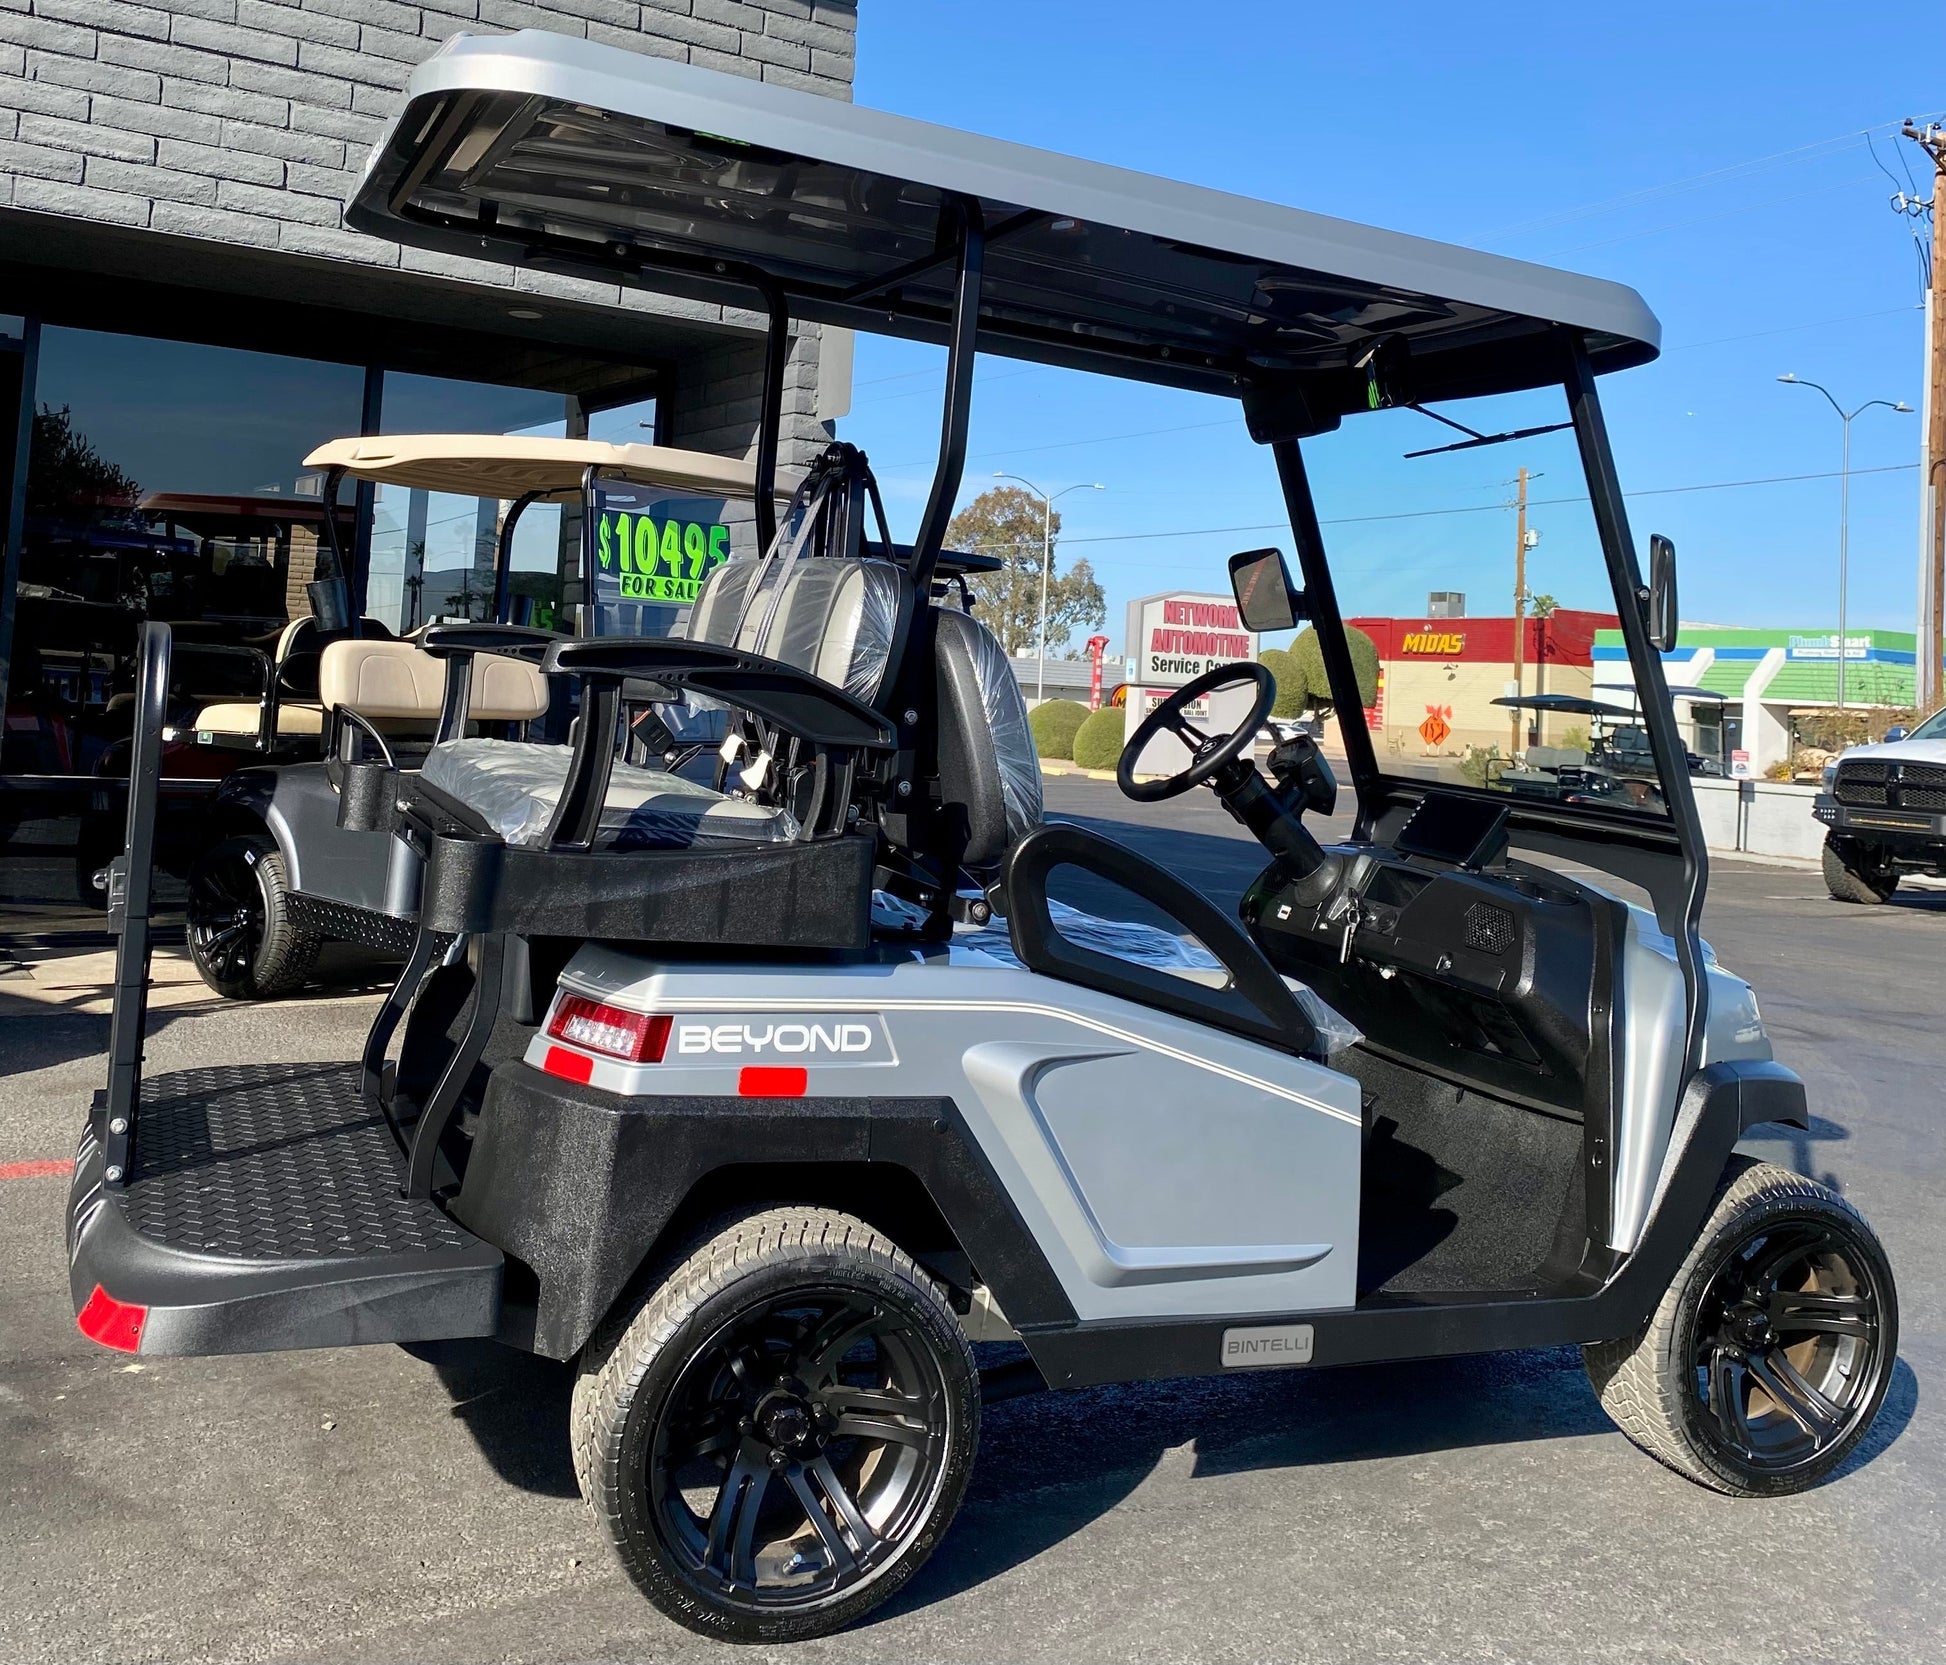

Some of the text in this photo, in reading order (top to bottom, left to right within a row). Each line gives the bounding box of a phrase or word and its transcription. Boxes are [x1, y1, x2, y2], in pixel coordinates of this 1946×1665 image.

[599, 513, 729, 580] $10495
[622, 576, 656, 597] FOR
[1163, 600, 1239, 629] NETWORK
[1150, 628, 1249, 659] AUTOMOTIVE
[1402, 633, 1464, 655] MIDAS
[1151, 656, 1200, 674] Service
[678, 1024, 872, 1053] BEYOND
[1227, 1337, 1309, 1354] BINTELLI
